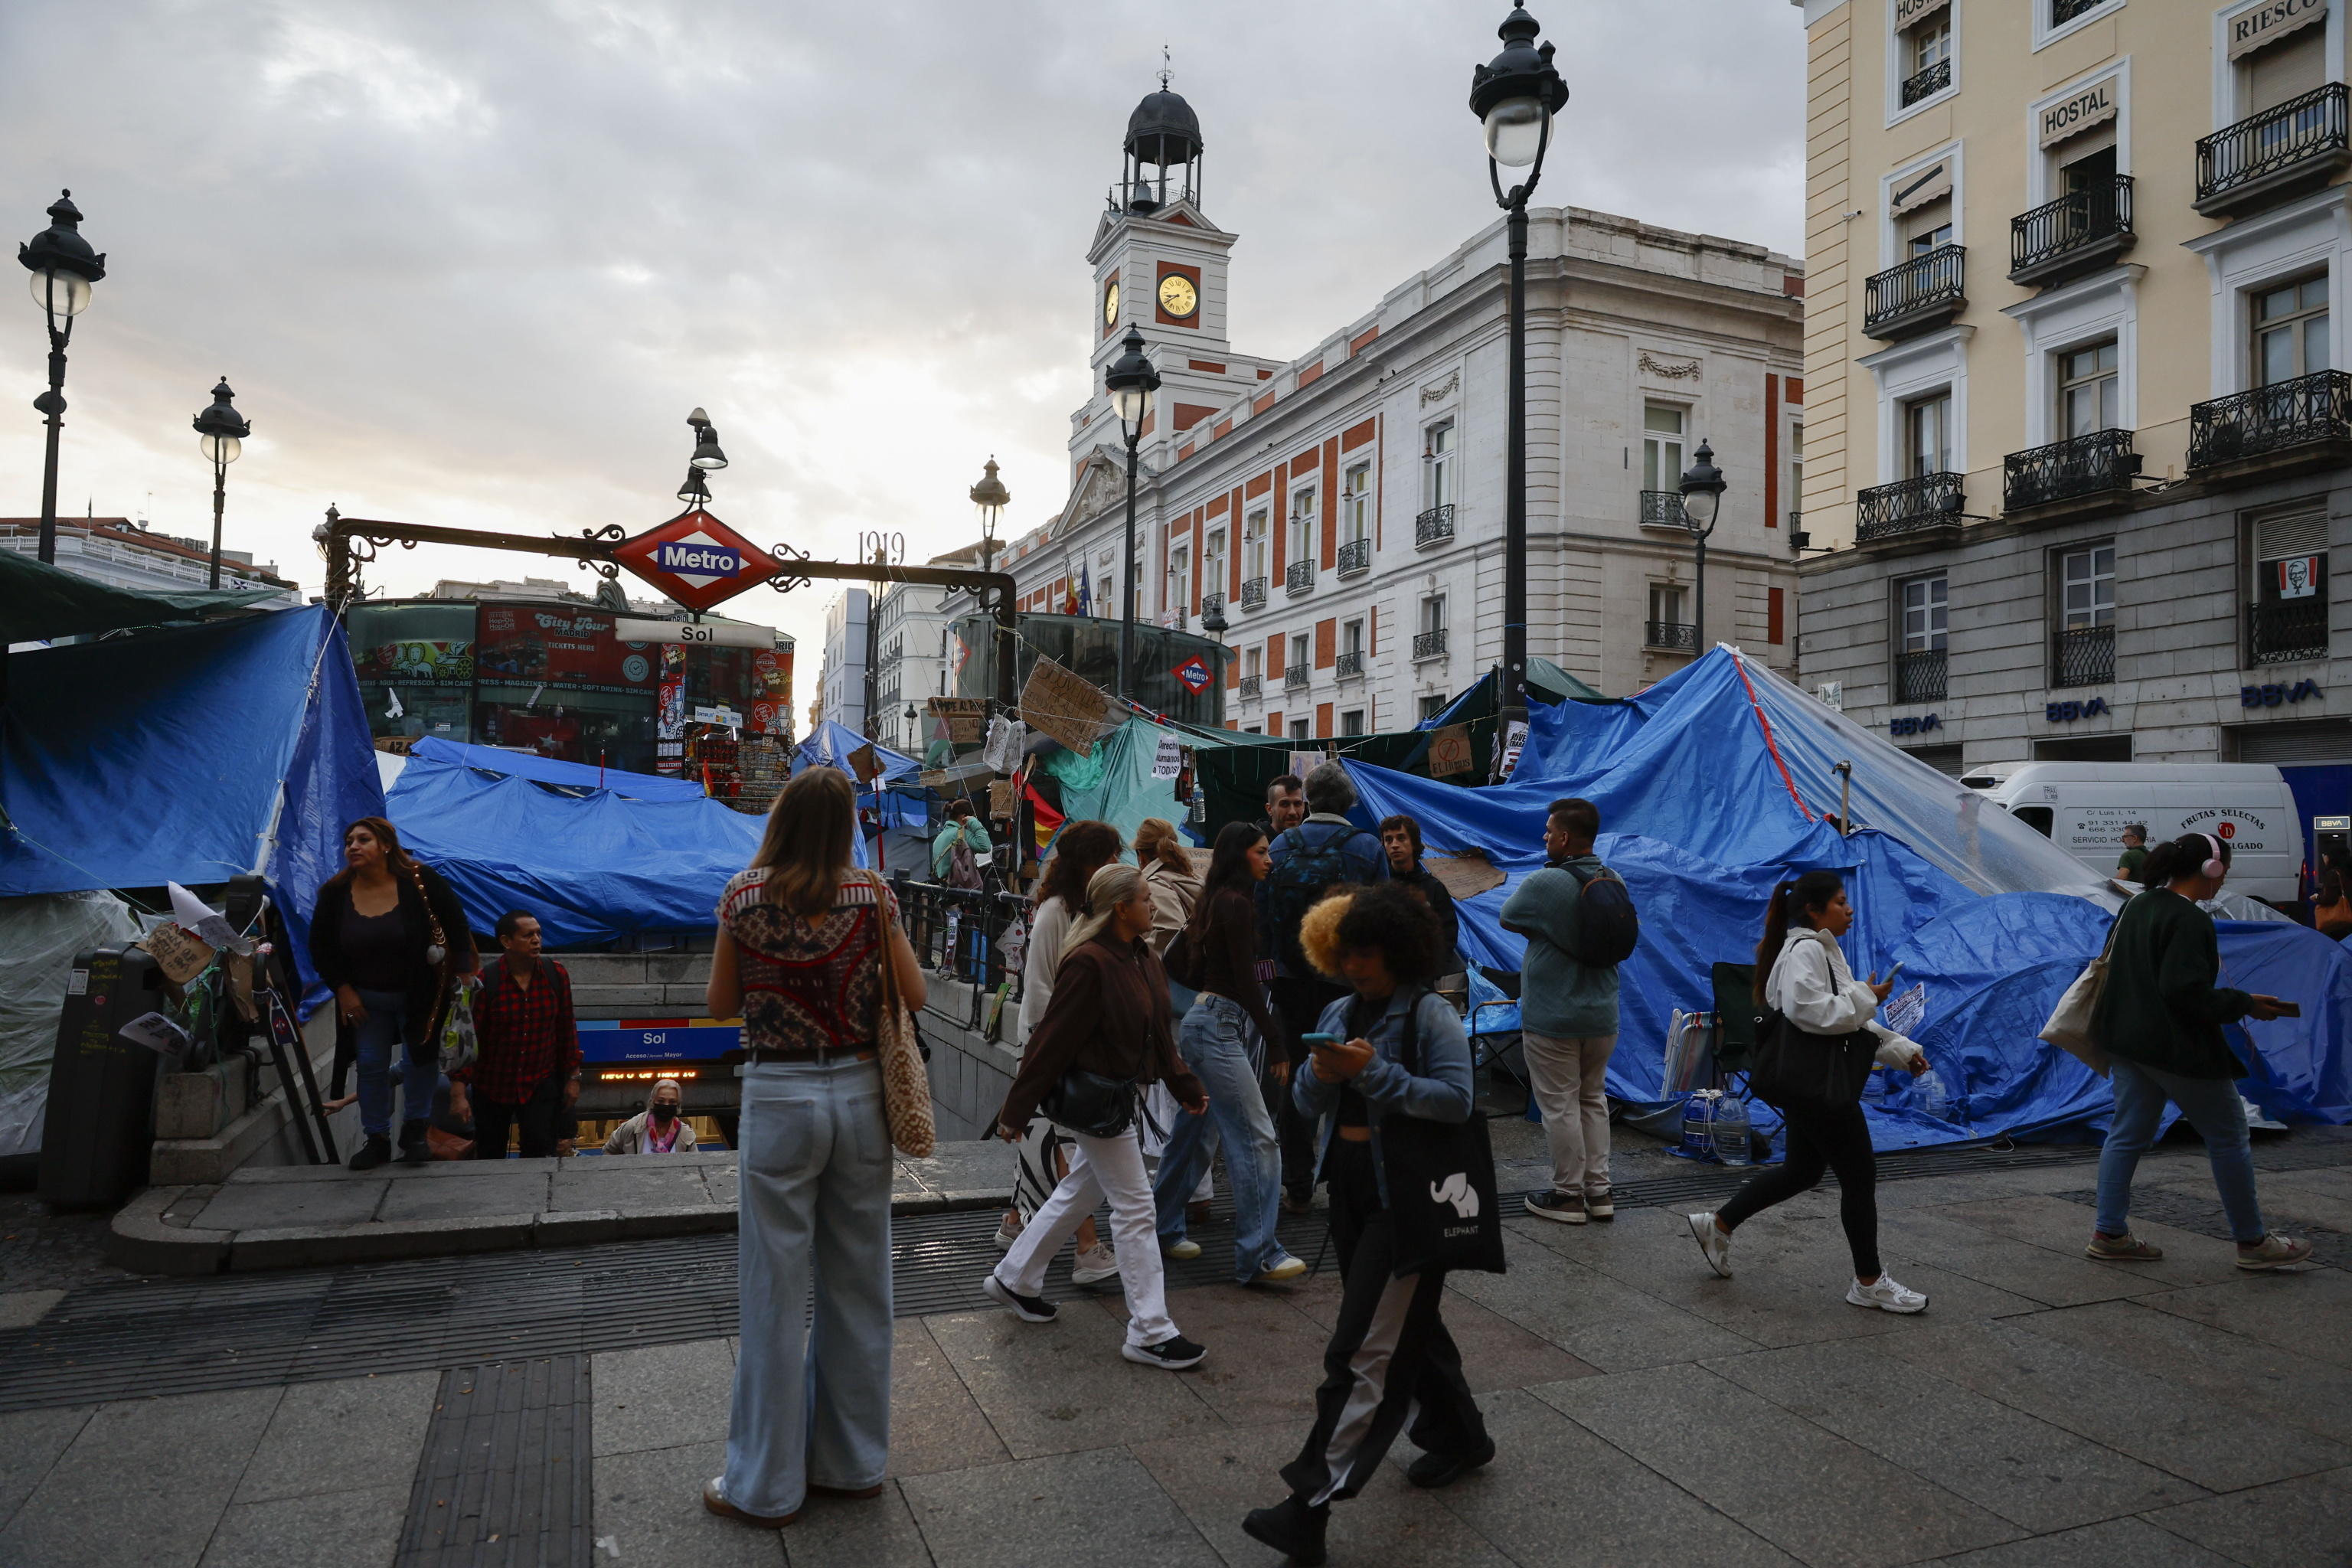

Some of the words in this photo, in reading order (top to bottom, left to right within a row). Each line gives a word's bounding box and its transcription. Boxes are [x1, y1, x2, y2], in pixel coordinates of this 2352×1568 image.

[2045, 88, 2109, 134] HOSTAL
[858, 531, 905, 566] 1919
[665, 546, 734, 571] Metro
[535, 613, 571, 630] City
[573, 617, 609, 631] Tour
[554, 629, 590, 639] MADRID
[681, 626, 713, 642] Sol
[547, 642, 575, 650] TICKETS
[1185, 668, 1206, 681] Metro
[600, 685, 622, 694] DRINK
[2240, 678, 2323, 707] BBVA
[2046, 697, 2110, 722] BBVA
[1890, 714, 1943, 735] BBVA
[1158, 740, 1179, 750] Derech
[2180, 809, 2216, 829] FRUTAS
[2221, 808, 2266, 830] SELECTAS
[2226, 826, 2233, 837] D
[643, 1033, 666, 1044] Sol
[1444, 1225, 1479, 1238] ELEPHANT
